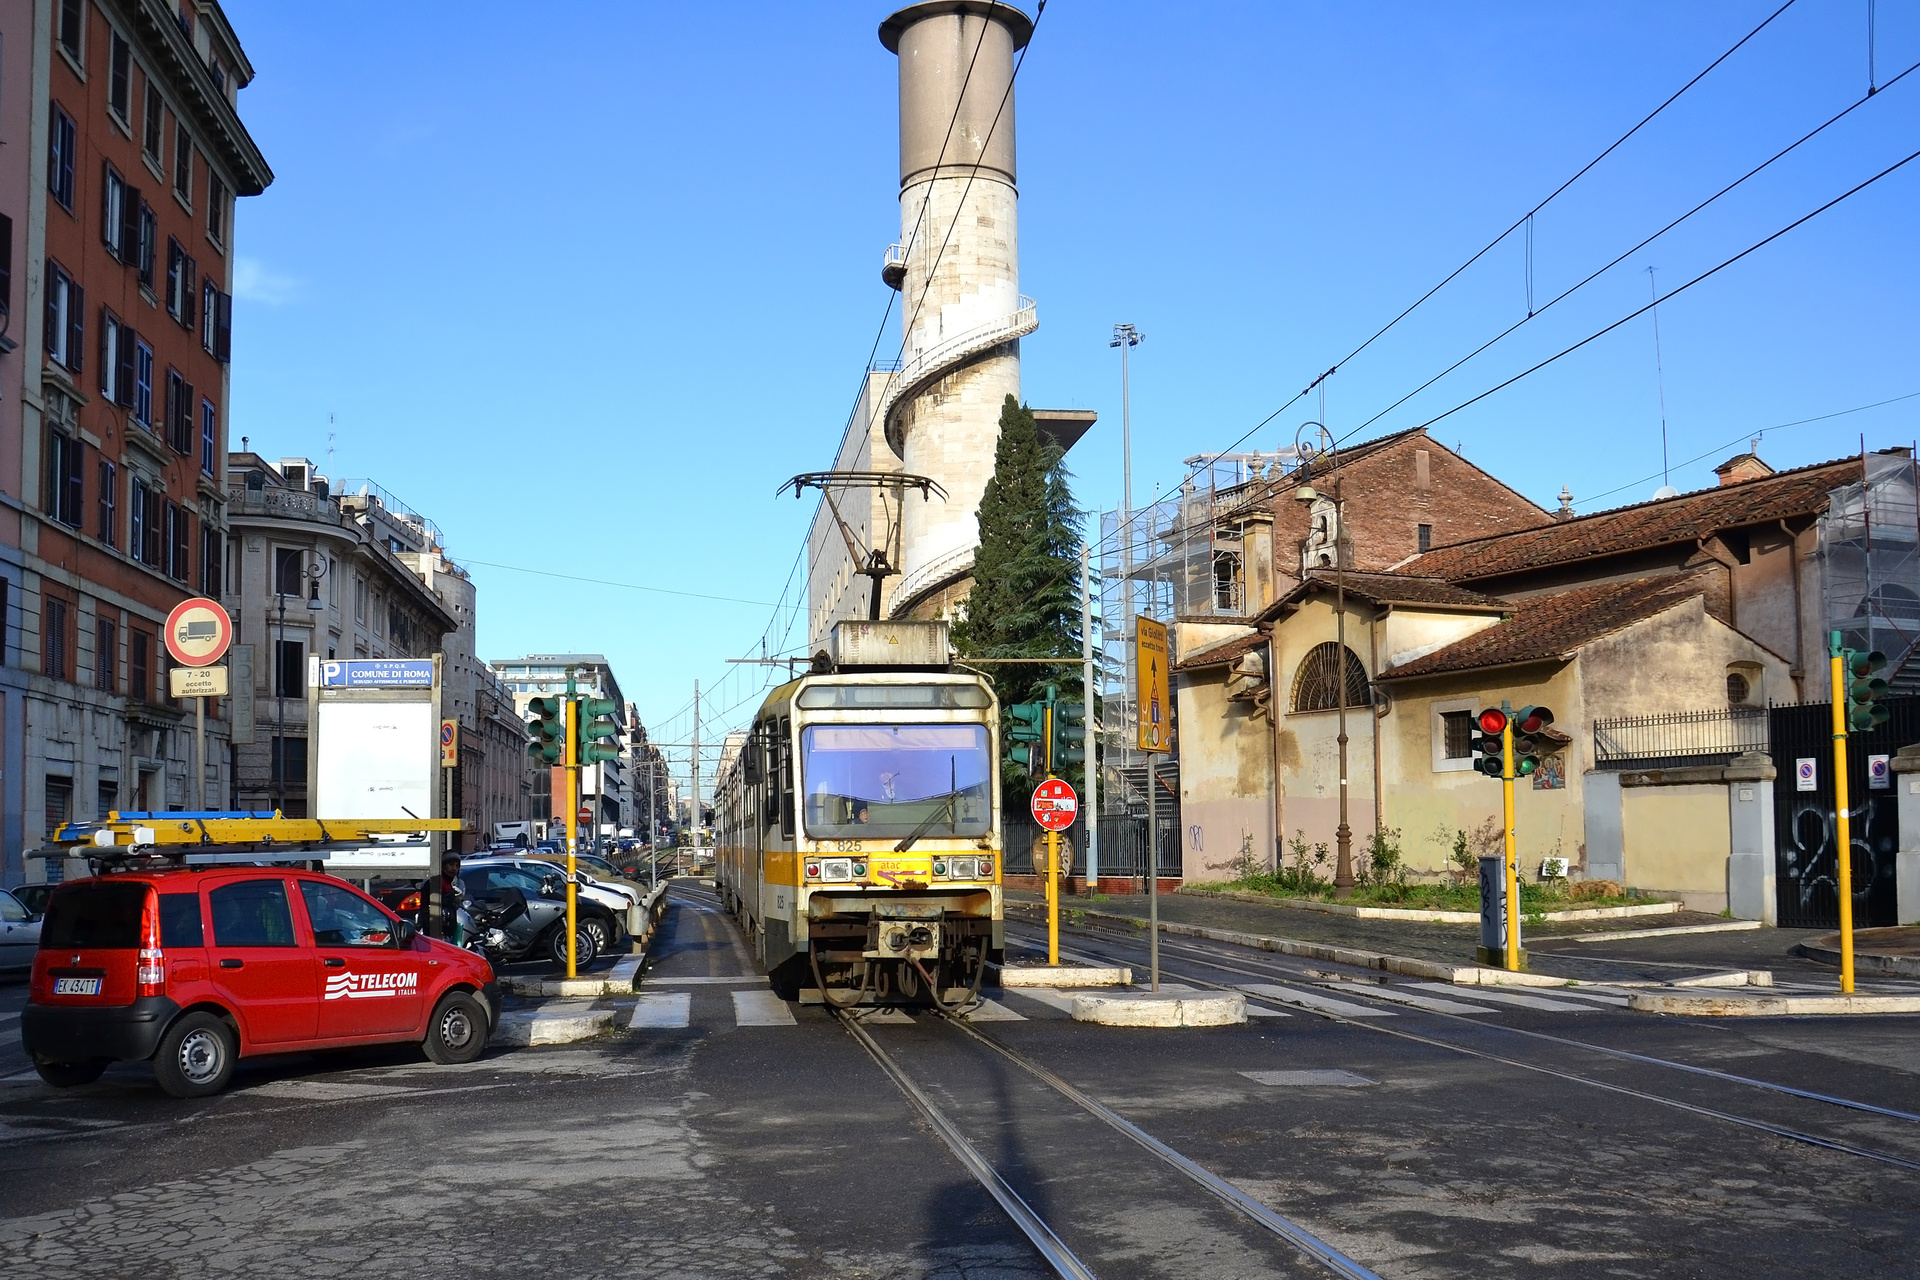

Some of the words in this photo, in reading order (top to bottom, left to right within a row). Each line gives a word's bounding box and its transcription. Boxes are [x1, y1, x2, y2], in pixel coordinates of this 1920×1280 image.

[200, 670, 211, 678] 20
[351, 670, 390, 678] COMUNE
[391, 670, 402, 678] DI
[403, 670, 431, 678] ROMA
[181, 687, 217, 695] autorizzati
[837, 840, 862, 852] 825
[880, 861, 901, 870] atac
[360, 972, 418, 990] TELECOM
[398, 988, 417, 996] ITALIA
